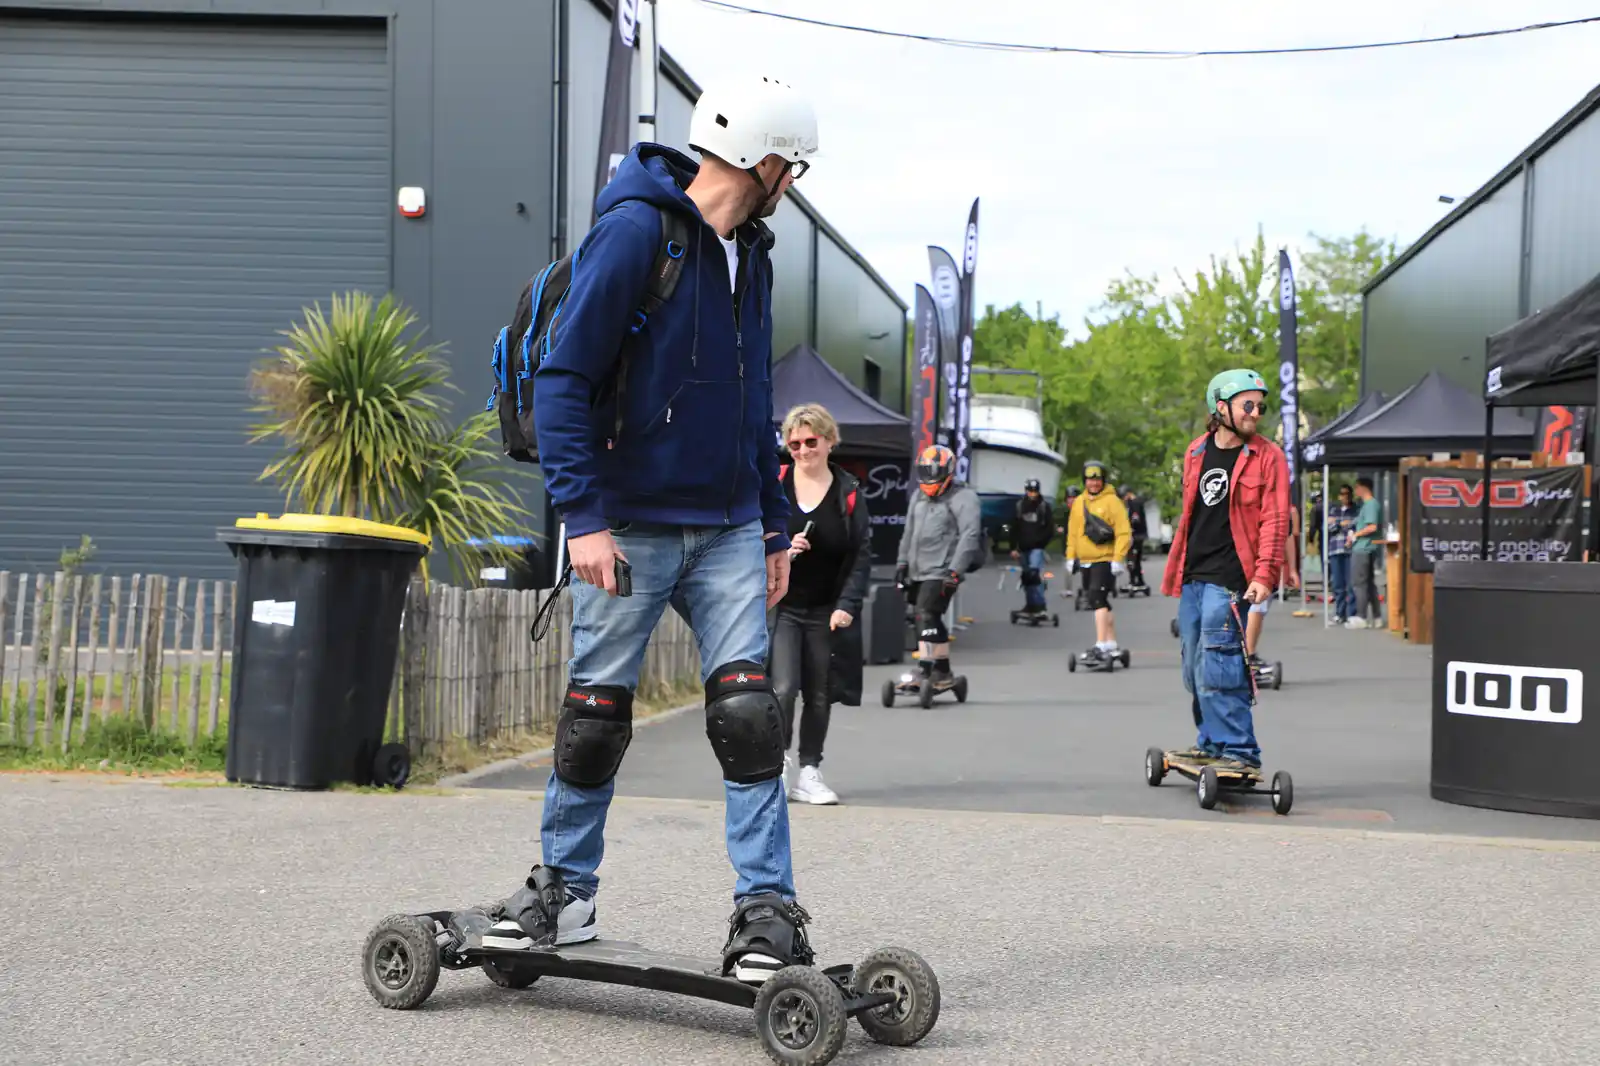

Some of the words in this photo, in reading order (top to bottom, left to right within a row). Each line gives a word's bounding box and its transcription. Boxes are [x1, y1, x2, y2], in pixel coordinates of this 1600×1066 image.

[1419, 478, 1525, 507] EVO
[1421, 537, 1496, 552] Electrc
[1499, 538, 1572, 554] mobility
